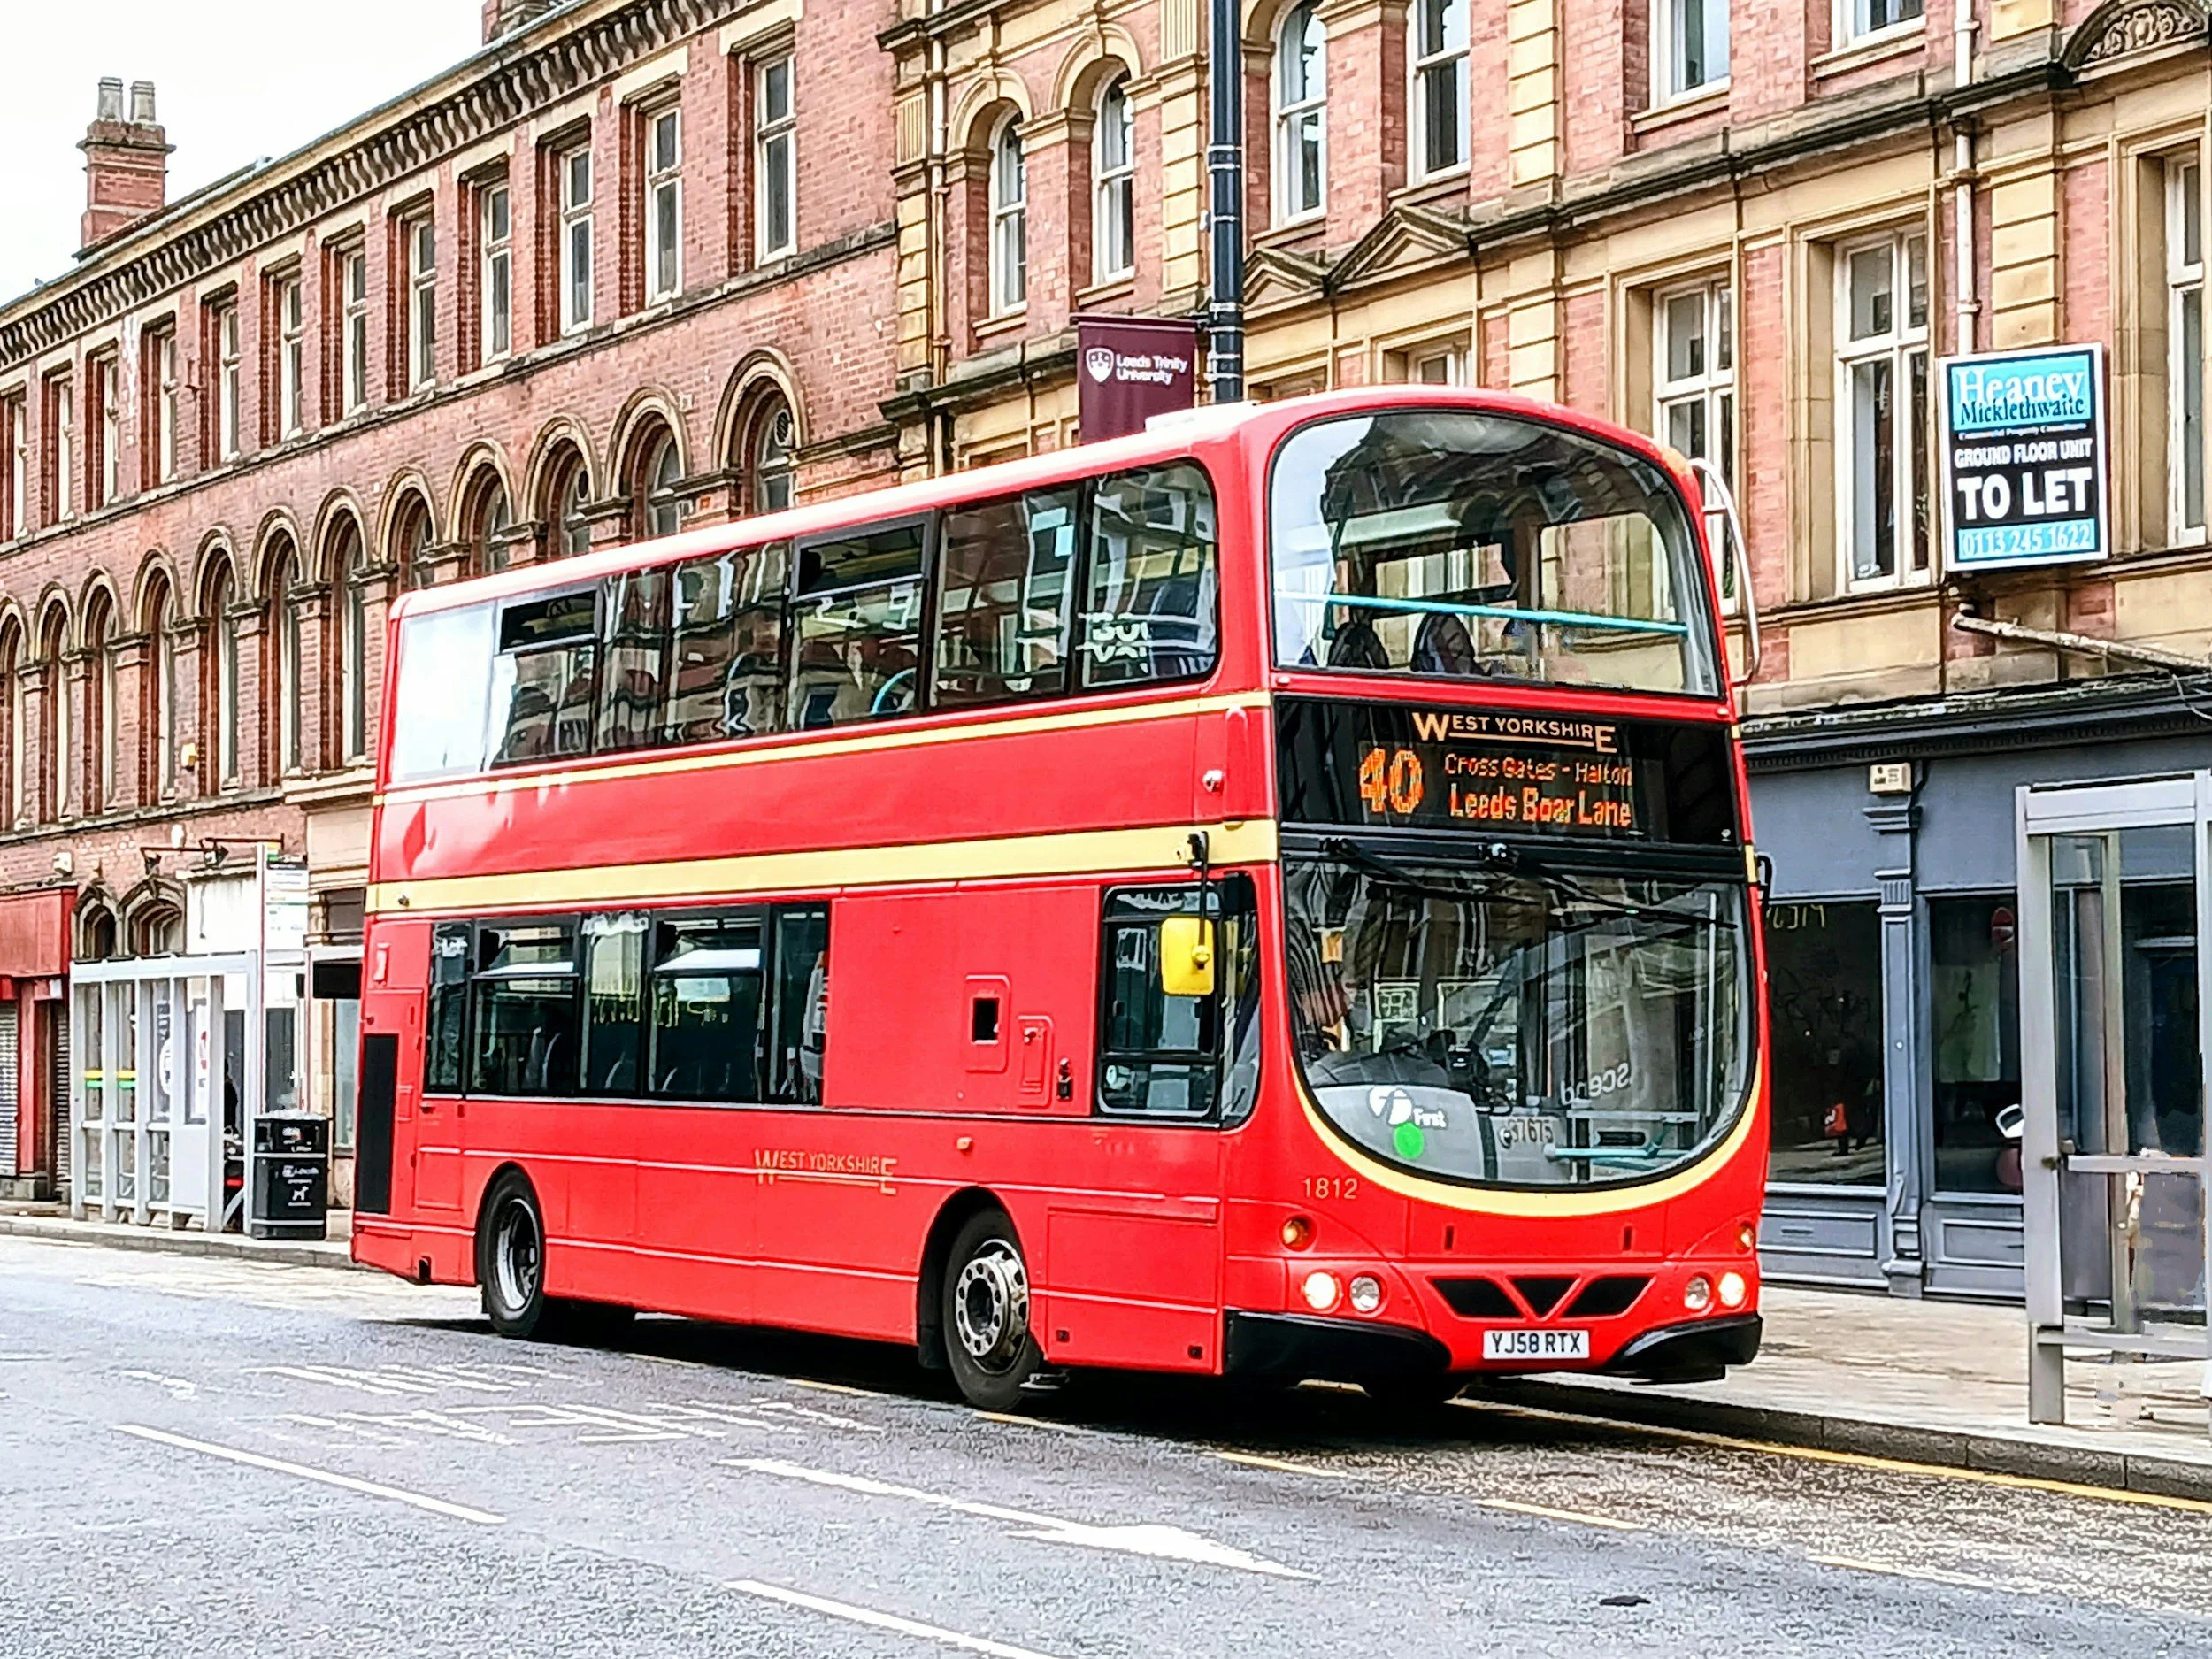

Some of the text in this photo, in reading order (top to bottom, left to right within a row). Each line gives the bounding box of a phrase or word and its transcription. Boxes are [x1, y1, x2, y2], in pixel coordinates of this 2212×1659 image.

[1116, 354, 1187, 373] Leeds Trinity
[1116, 368, 1173, 385] University
[1957, 368, 2085, 404] Heaney
[1961, 394, 2085, 426] Micklethwaite
[1955, 437, 2093, 468] GROUND FLOOR UNIT
[1957, 467, 2093, 521] TO LET
[1962, 524, 2091, 556] 0113 245 1622
[1412, 712, 1618, 753] WEST YORKSHIRE
[1359, 748, 1424, 814] 40
[1444, 753, 1499, 777] Cross
[1502, 757, 1556, 780] Gates
[1575, 761, 1633, 786] Halton
[1448, 783, 1632, 827] Leeds Boar Lane
[1413, 1107, 1448, 1128] First
[755, 1148, 898, 1195] WEST YORKSHIRE
[1302, 1177, 1357, 1200] 1812
[1492, 1333, 1581, 1354] YJ58 RTX
